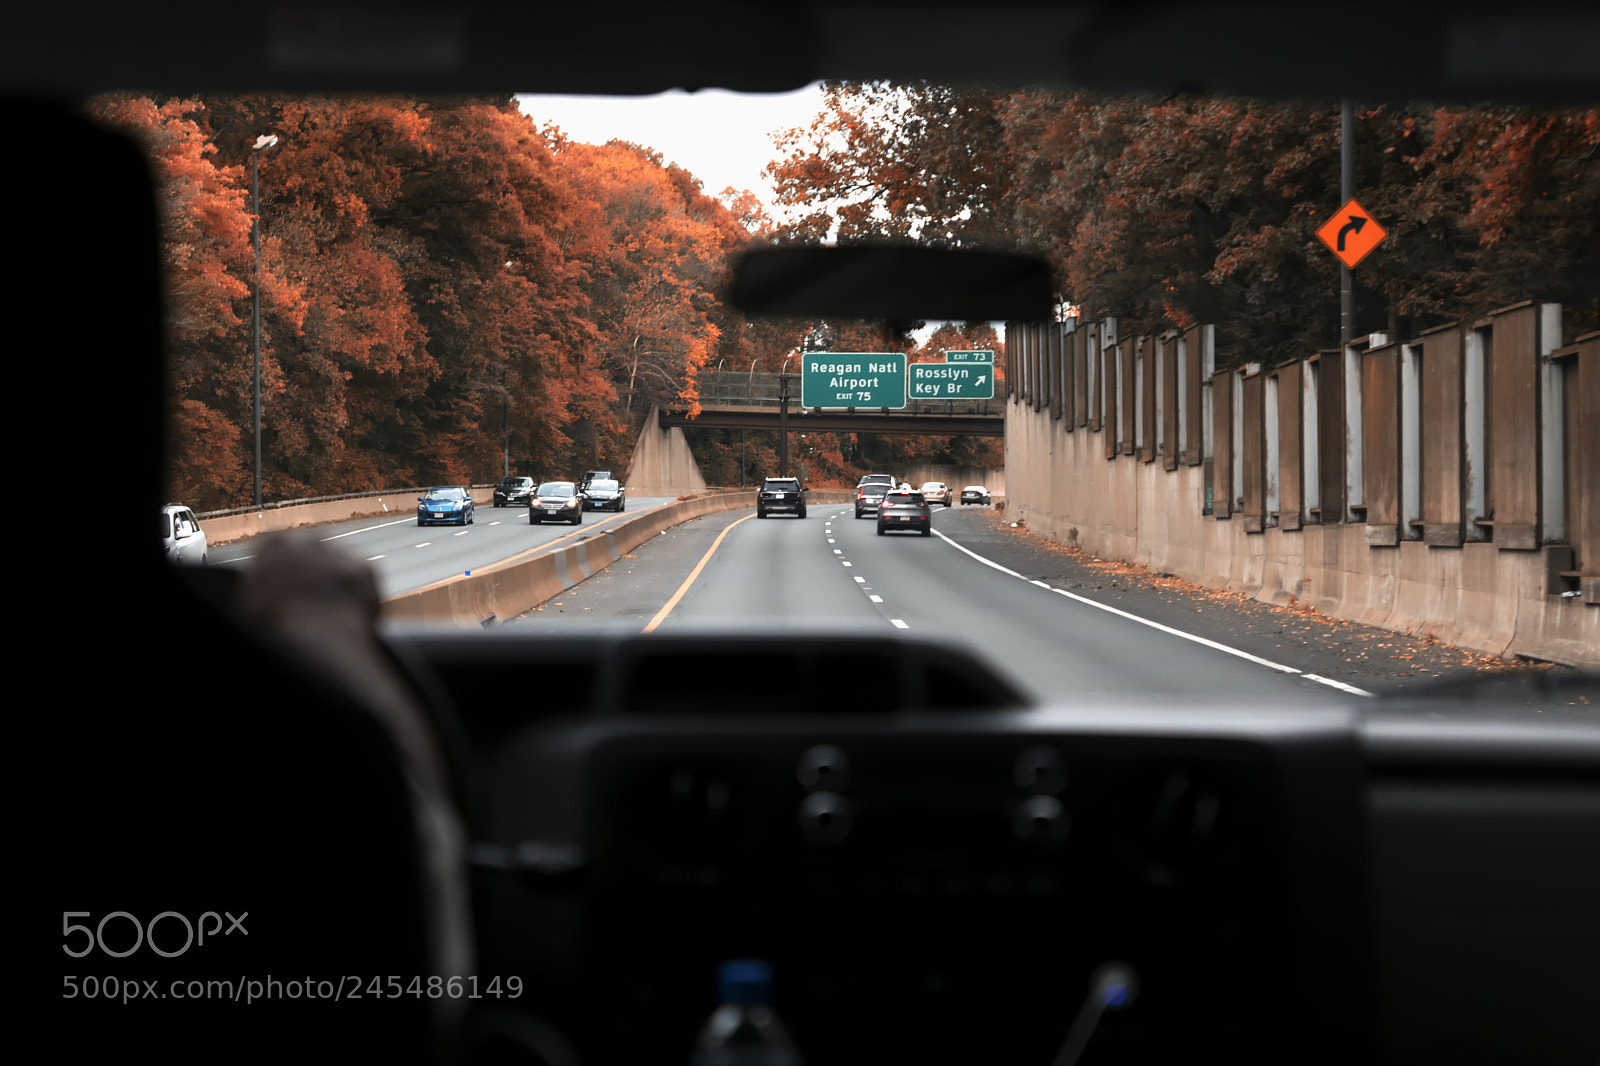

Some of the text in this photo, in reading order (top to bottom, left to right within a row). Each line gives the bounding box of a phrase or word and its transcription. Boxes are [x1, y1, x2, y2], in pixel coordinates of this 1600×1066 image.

[973, 353, 986, 361] 73
[811, 362, 897, 375] Reagan Natl
[916, 368, 969, 380] Rosslyn
[829, 377, 879, 389] Airport
[916, 383, 962, 395] Key Br
[857, 392, 871, 401] 75
